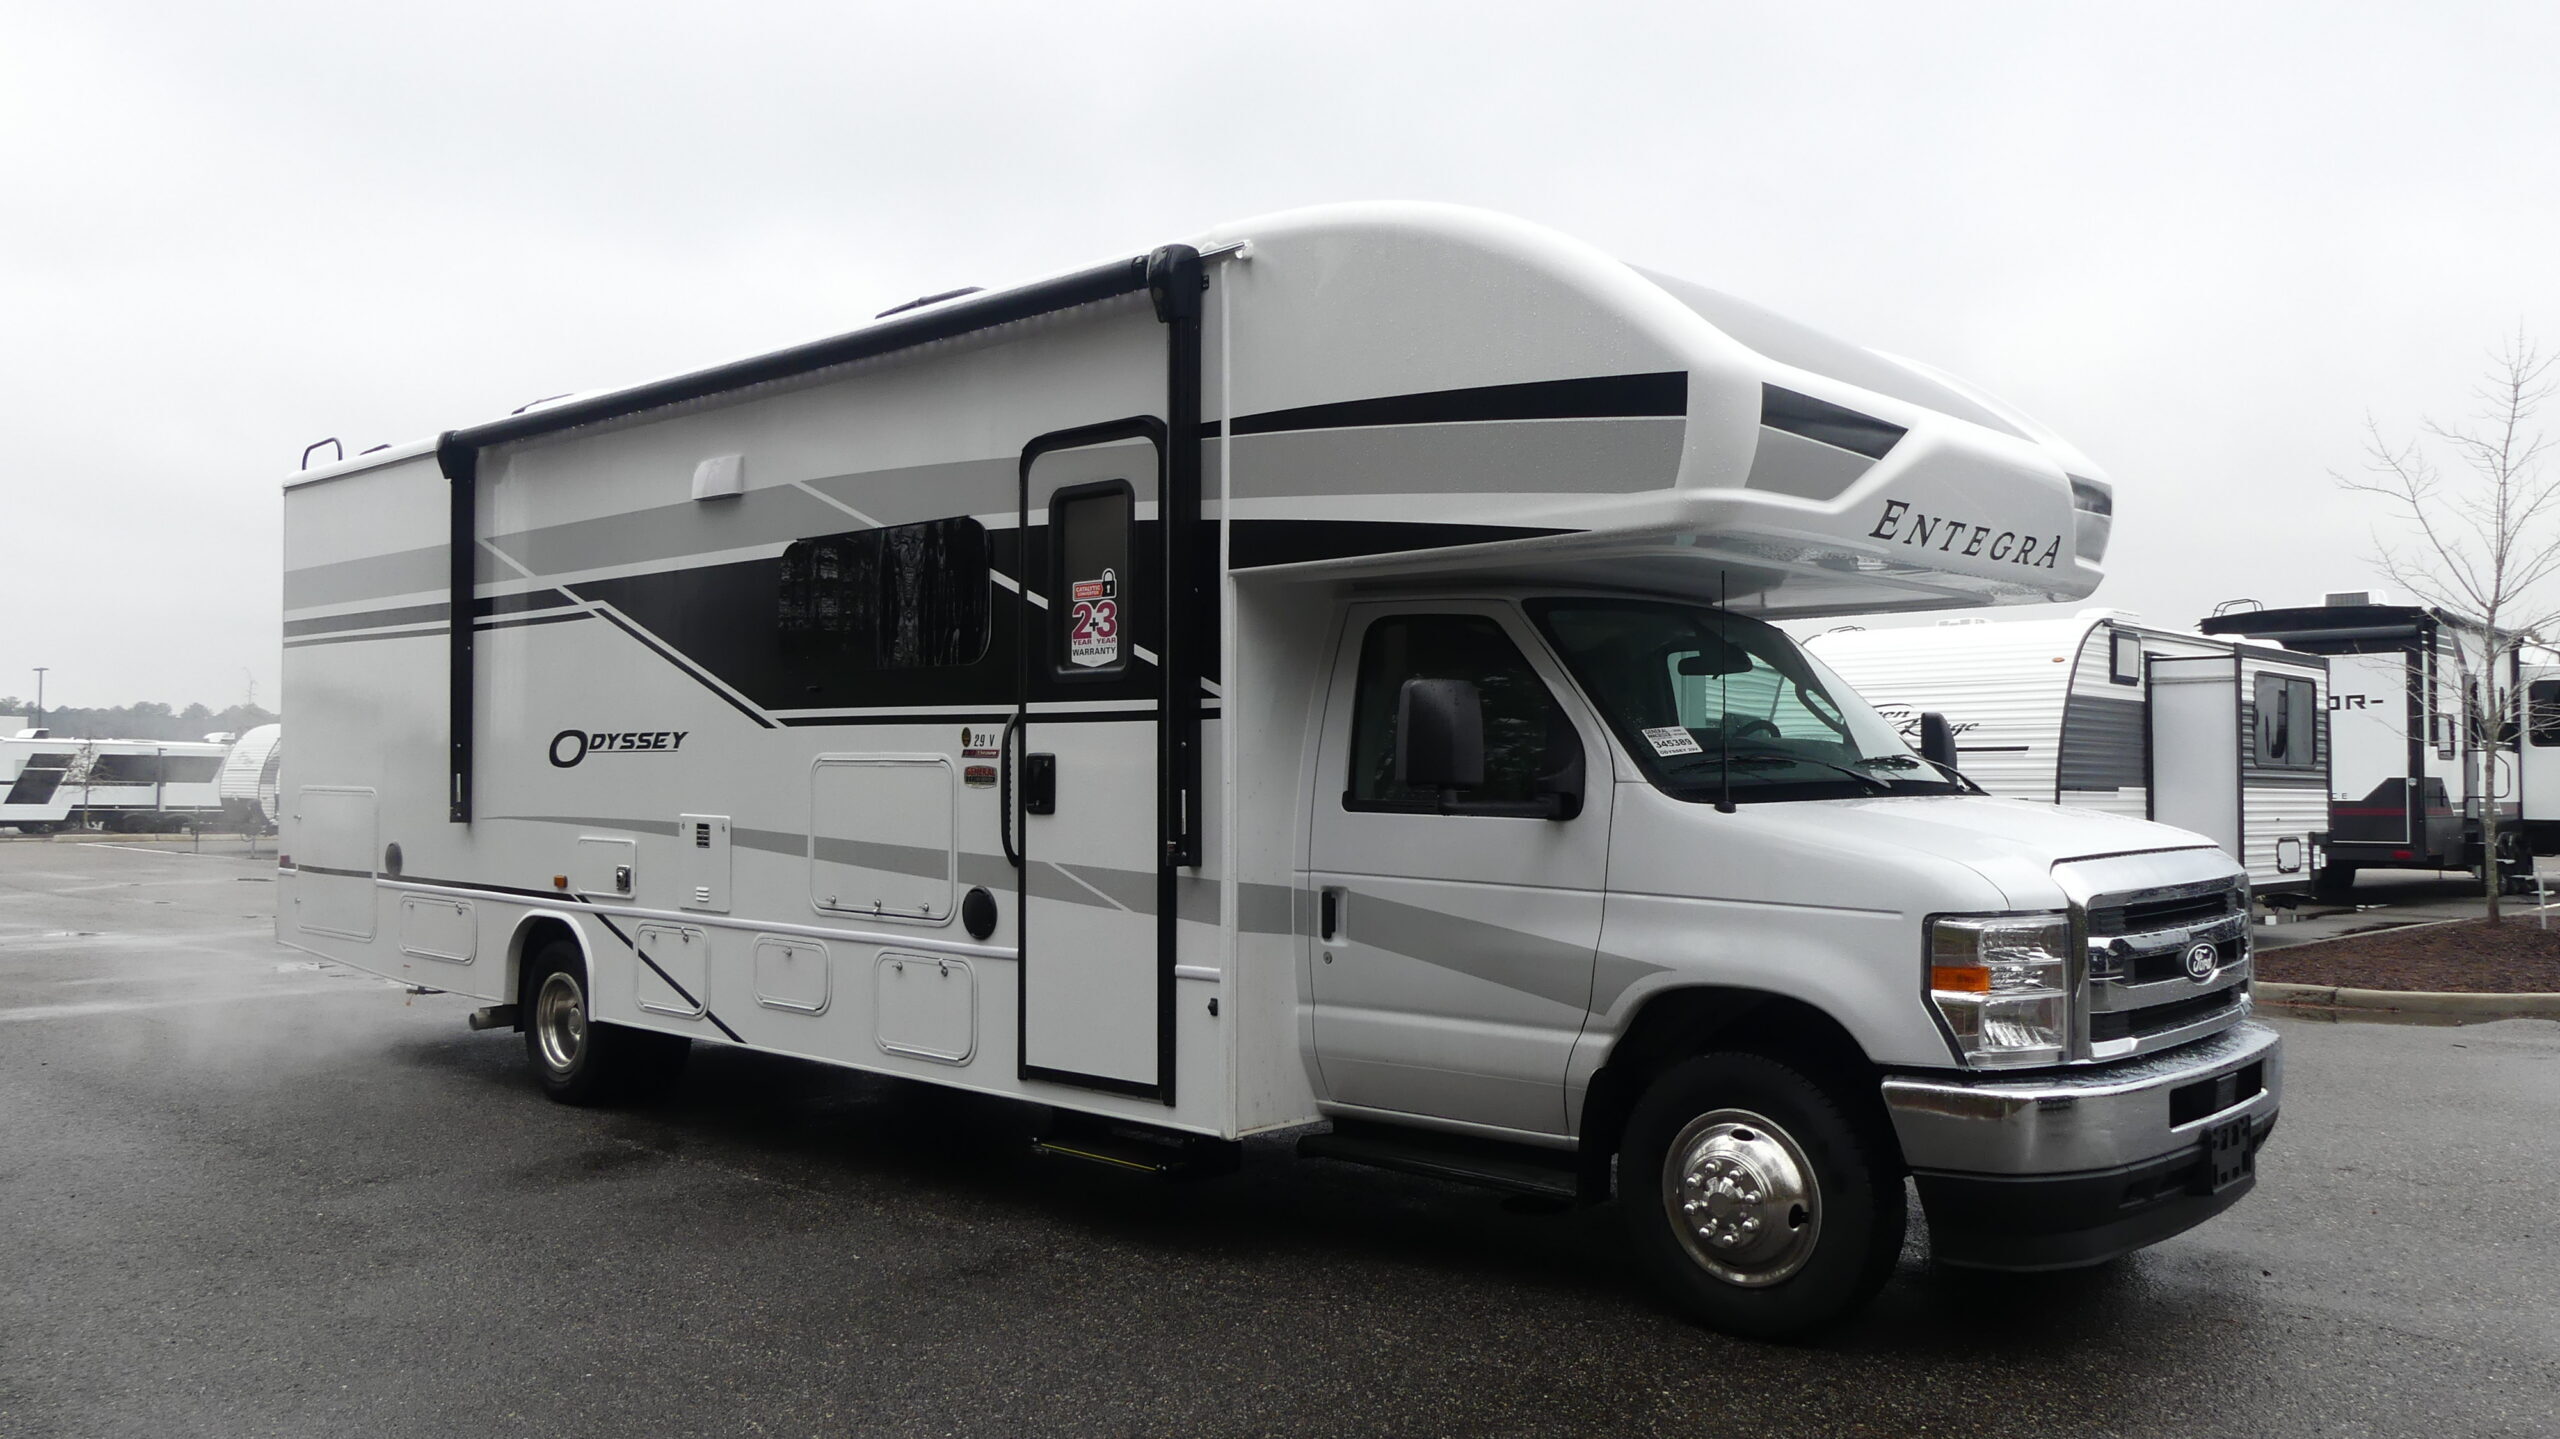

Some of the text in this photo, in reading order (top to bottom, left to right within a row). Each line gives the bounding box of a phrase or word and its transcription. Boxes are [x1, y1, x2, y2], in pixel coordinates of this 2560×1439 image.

[1868, 499, 2061, 569] ENTEGRA
[1075, 584, 1101, 592] CATALYTIC
[1097, 637, 1116, 645] YEAR
[1072, 647, 1116, 656] WARRANTY
[973, 734, 985, 747] 29
[989, 734, 995, 747] V
[1653, 738, 1693, 749] 345389
[548, 729, 689, 768] ODYSSEY
[2192, 948, 2214, 973] Ford
